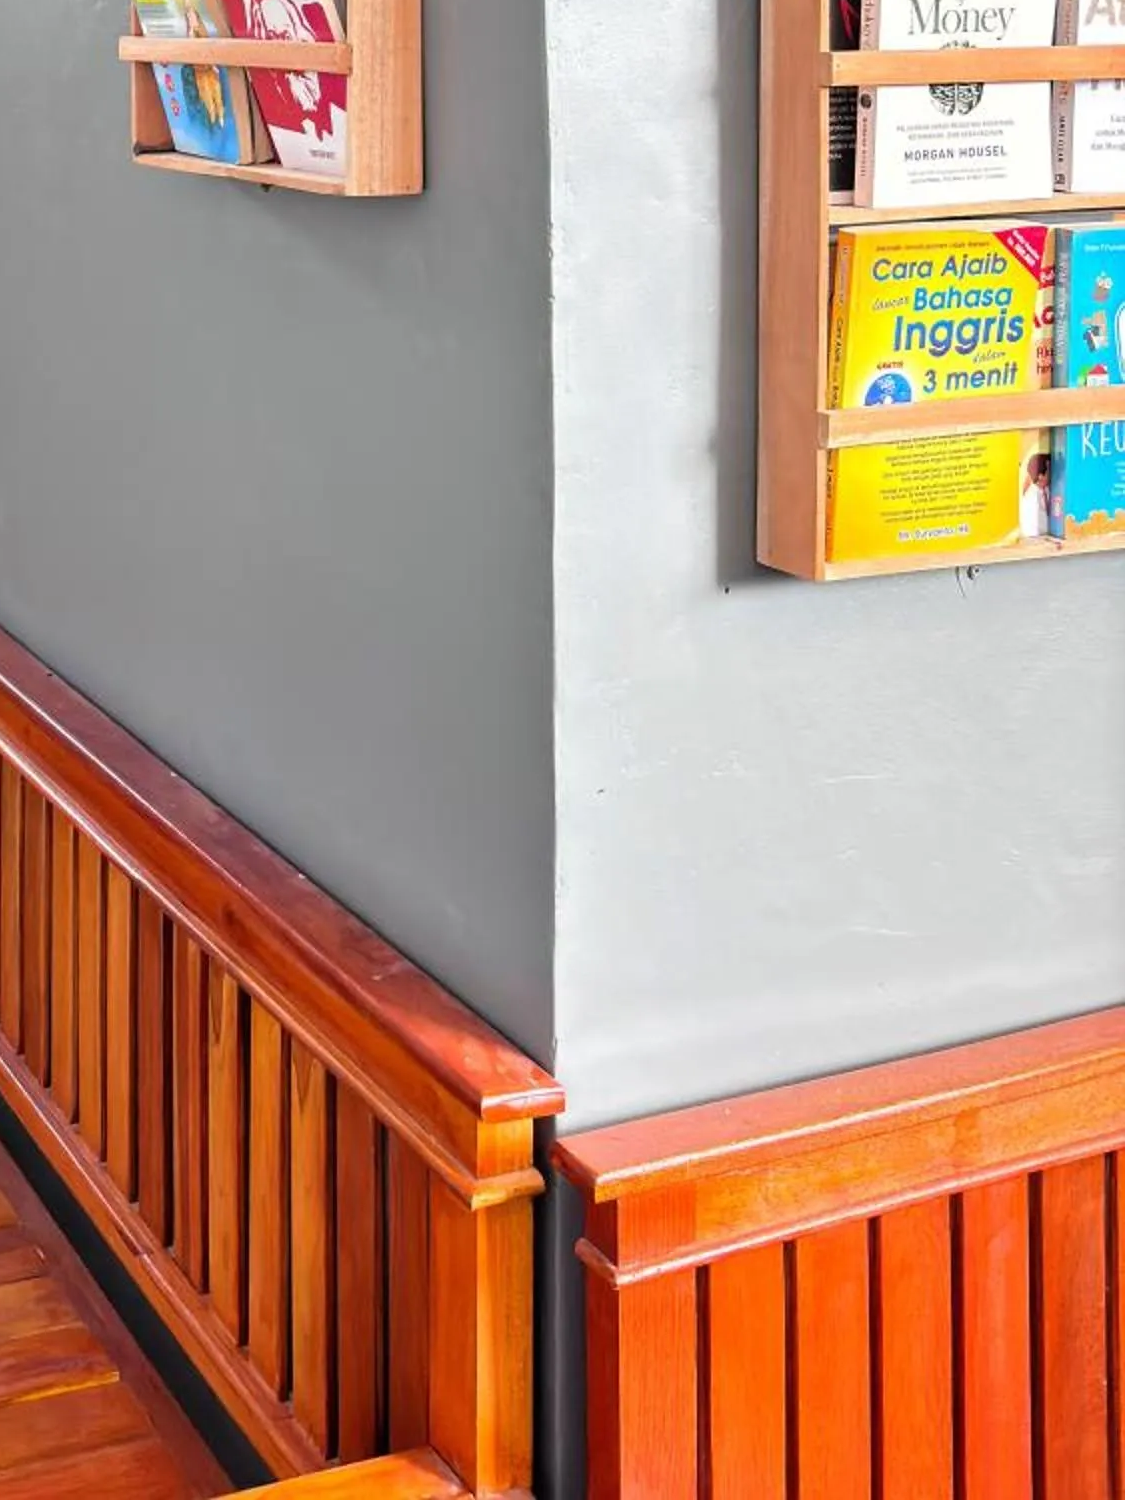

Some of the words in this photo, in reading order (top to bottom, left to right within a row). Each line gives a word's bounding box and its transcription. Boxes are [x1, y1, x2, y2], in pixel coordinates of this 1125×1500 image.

[904, 148, 955, 163] MORGAN
[958, 145, 1007, 160] HOUSEL
[871, 257, 933, 281] Cara
[940, 252, 1008, 281] Ajaib
[913, 286, 1013, 312] Bahasa
[892, 308, 1025, 357] Inggris
[922, 370, 938, 394] 3
[945, 361, 1018, 392] menit
